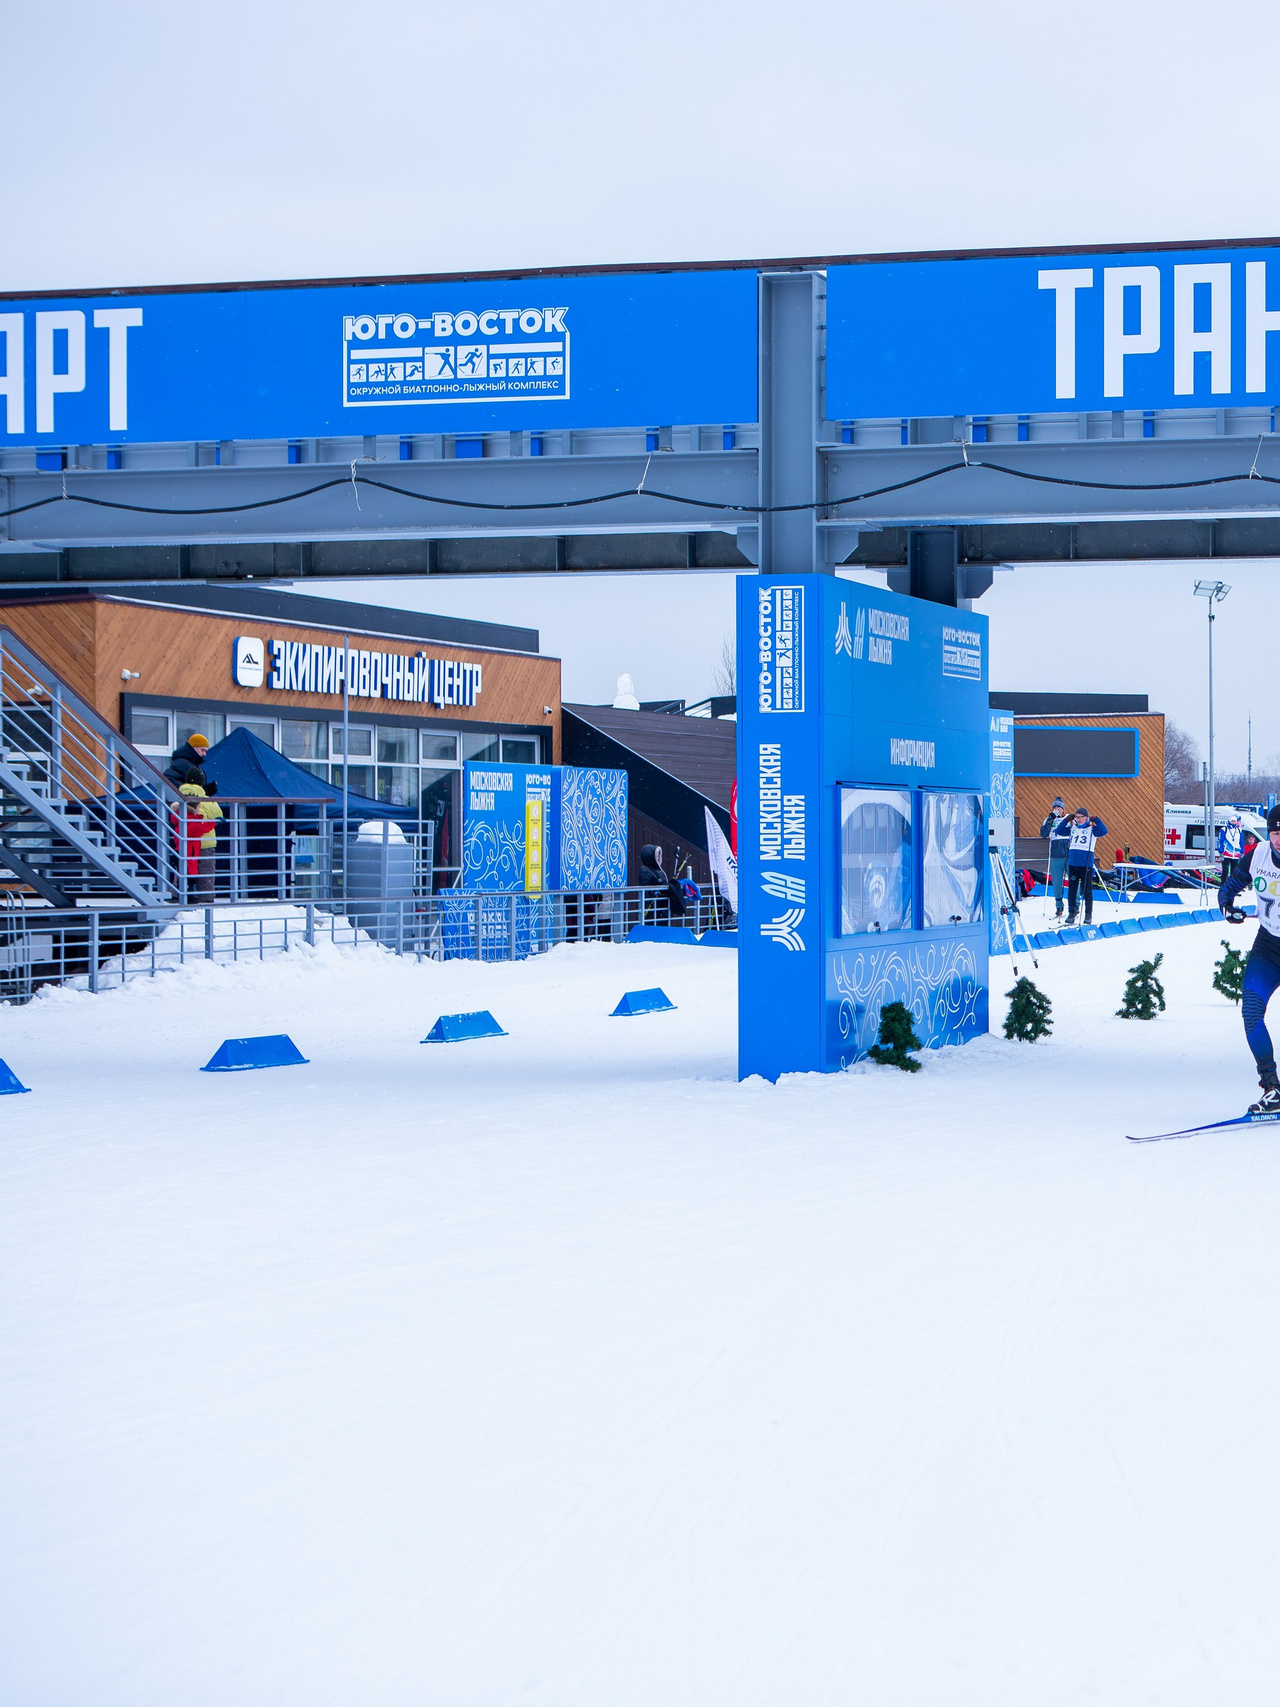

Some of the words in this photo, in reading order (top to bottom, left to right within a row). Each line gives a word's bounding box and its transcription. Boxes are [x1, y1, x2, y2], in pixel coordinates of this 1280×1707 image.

[343, 307, 569, 341] ЮГО-ВОСТОК
[350, 384, 401, 396] ОКРУЖНОЙ
[403, 381, 506, 394] БИАТЛОННО-ЛЫЖНЫЙ
[508, 380, 559, 390] КОМПЛЕКС
[868, 608, 909, 641] МОСКОВСКАЯ
[943, 626, 981, 646] ЮГО-ВОСТОК
[759, 586, 772, 713] ЮГО-ВОСТОК
[868, 637, 893, 665] ЛЫЖНЯ
[268, 640, 430, 703] ЭКИПИРОВОЧНЫЙ
[430, 659, 482, 709] ЦЕНТР
[890, 738, 935, 770] ИНФОРМАЦИЯ
[469, 771, 513, 791] МОСКОВСКАЯ
[469, 792, 495, 811] ЛЫЖНЯ
[759, 744, 781, 860] МОСКОВСКАЯ
[783, 795, 805, 860] ЛЫЖНЯ
[1251, 1114, 1278, 1122] SALOMON
